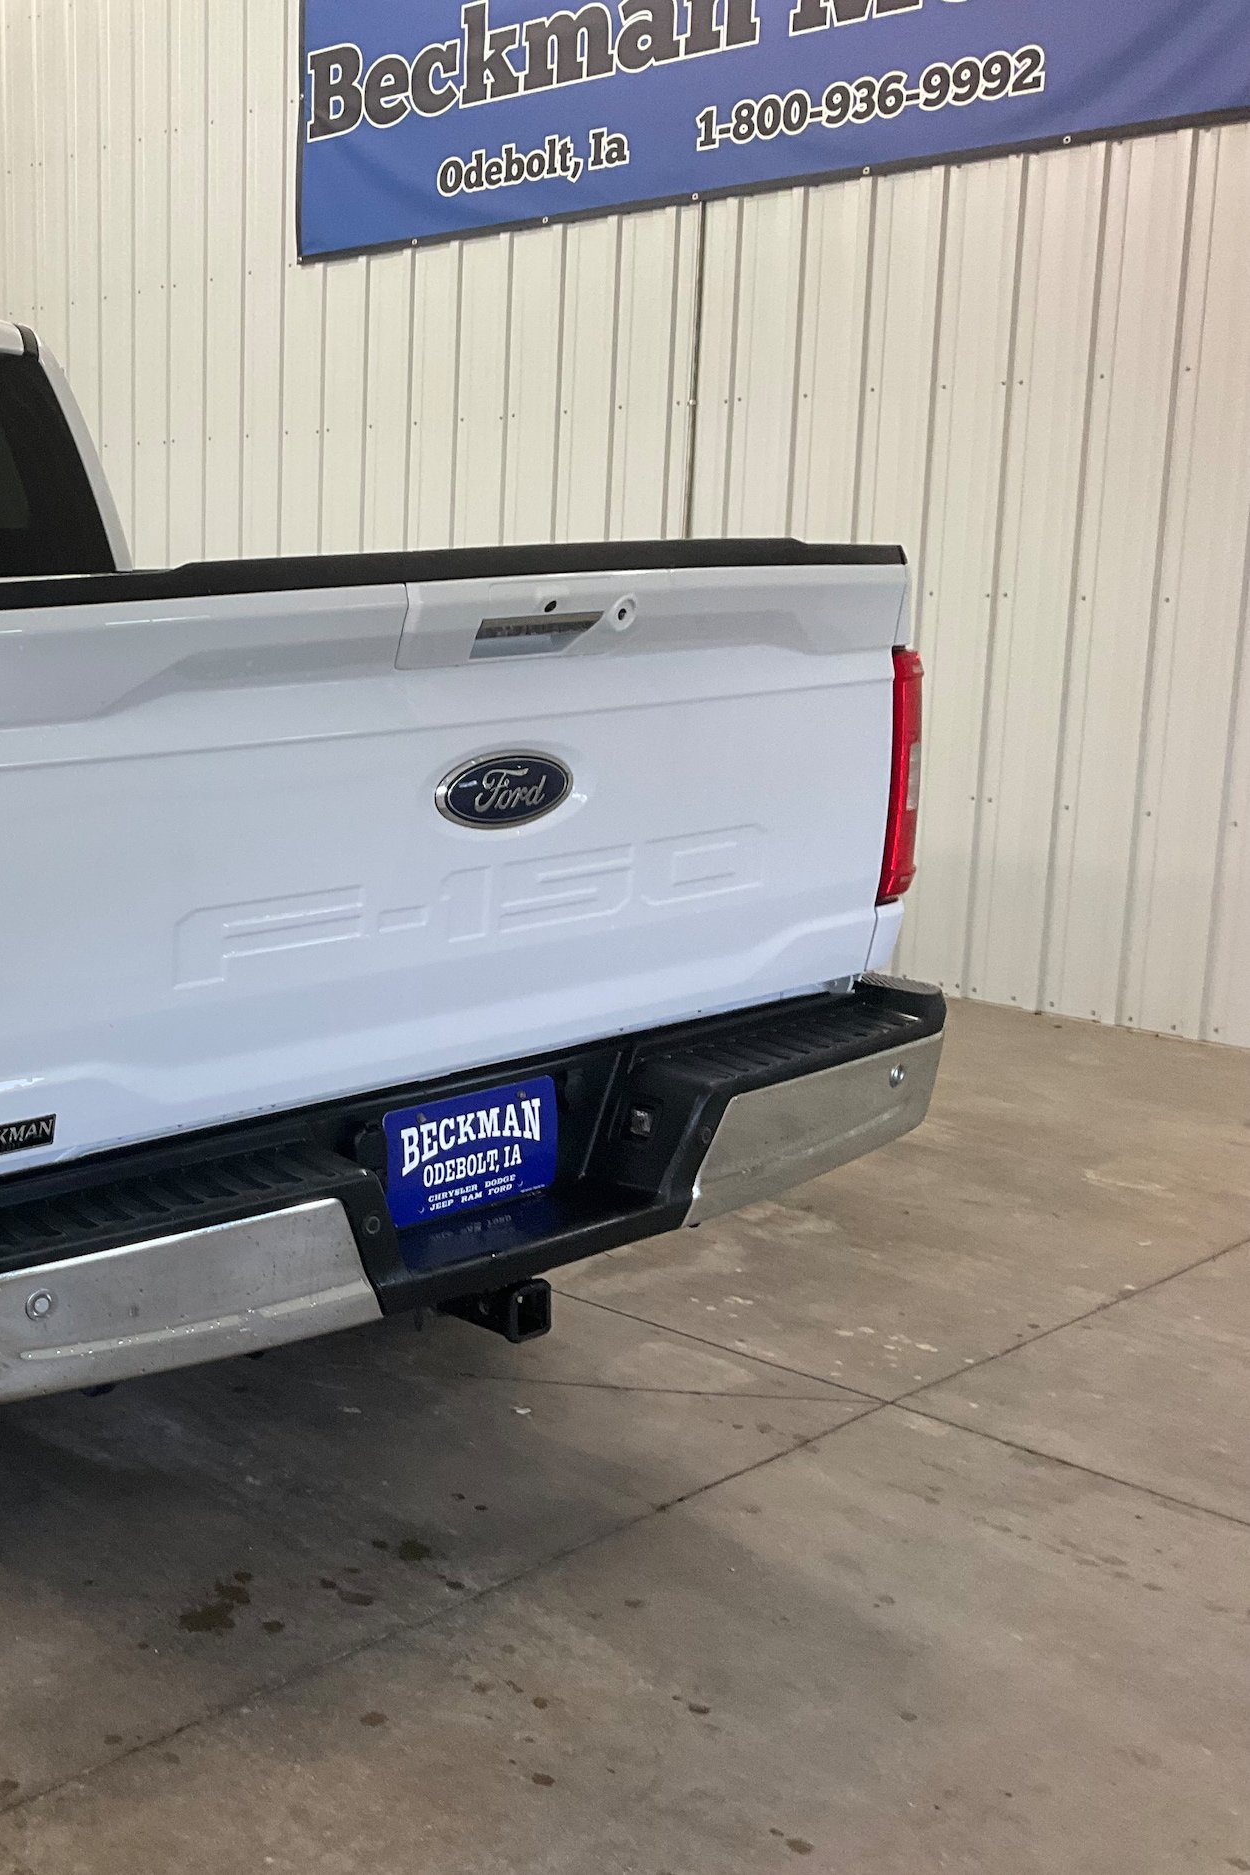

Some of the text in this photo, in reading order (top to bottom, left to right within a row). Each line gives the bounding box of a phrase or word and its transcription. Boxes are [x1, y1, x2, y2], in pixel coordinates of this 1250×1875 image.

[306, 0, 760, 143] Beckman
[696, 45, 1045, 151] 1-800-936-9992
[438, 128, 628, 196] Odebolt, Ia
[473, 764, 546, 814] Ford
[173, 822, 768, 990] F-150
[401, 1098, 540, 1176] BECKMAN
[423, 1144, 522, 1188] ODEBOLT, IA
[428, 1173, 516, 1203] CHRYSLER DODGE
[430, 1199, 454, 1212] JEEP
[461, 1191, 483, 1204] RAM
[488, 1183, 513, 1196] FORD
